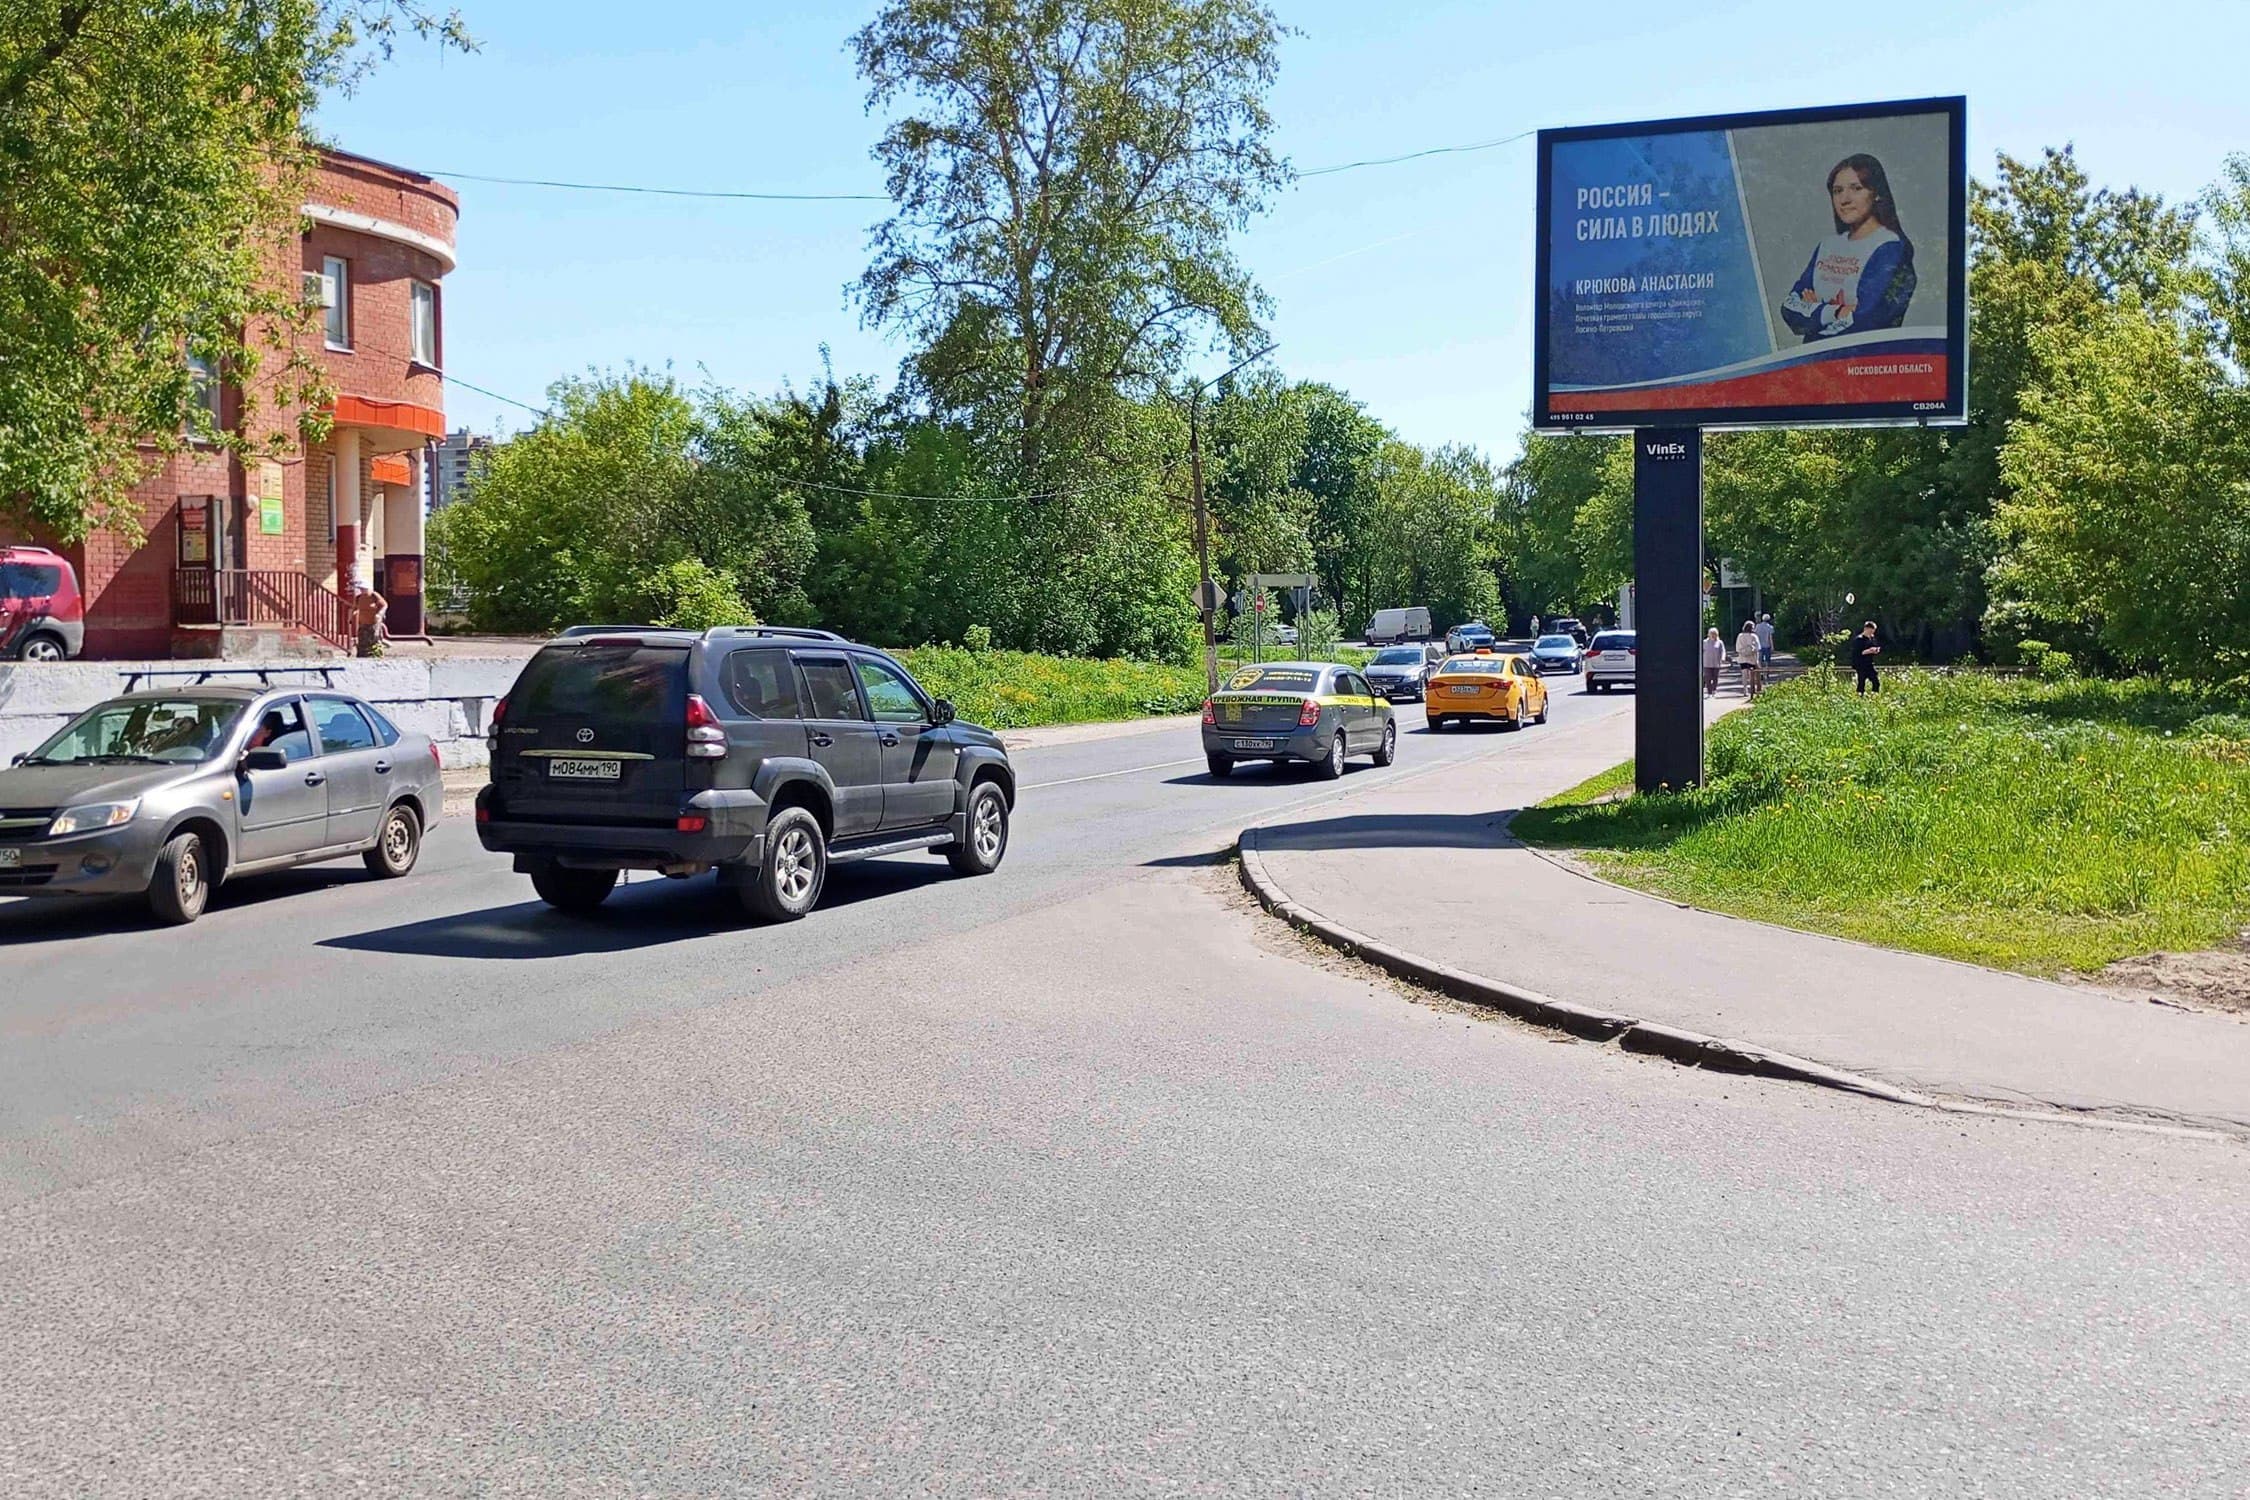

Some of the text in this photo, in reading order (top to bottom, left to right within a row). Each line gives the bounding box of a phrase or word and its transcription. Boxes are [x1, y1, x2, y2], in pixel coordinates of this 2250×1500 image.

[1576, 184, 1653, 210] РОССИЯ
[1576, 210, 1720, 241] СИЛА В ЛЮДЯХ
[1575, 272, 1715, 295] КРЮКОВА АНАСТАСИЯ
[1847, 363, 1933, 376] МОСКОВСКАЯ ОБЛАСТЬ
[1646, 443, 1686, 455] VinEx
[1212, 695, 1302, 704] ТРЕВОЖНАЯ ГРУППА
